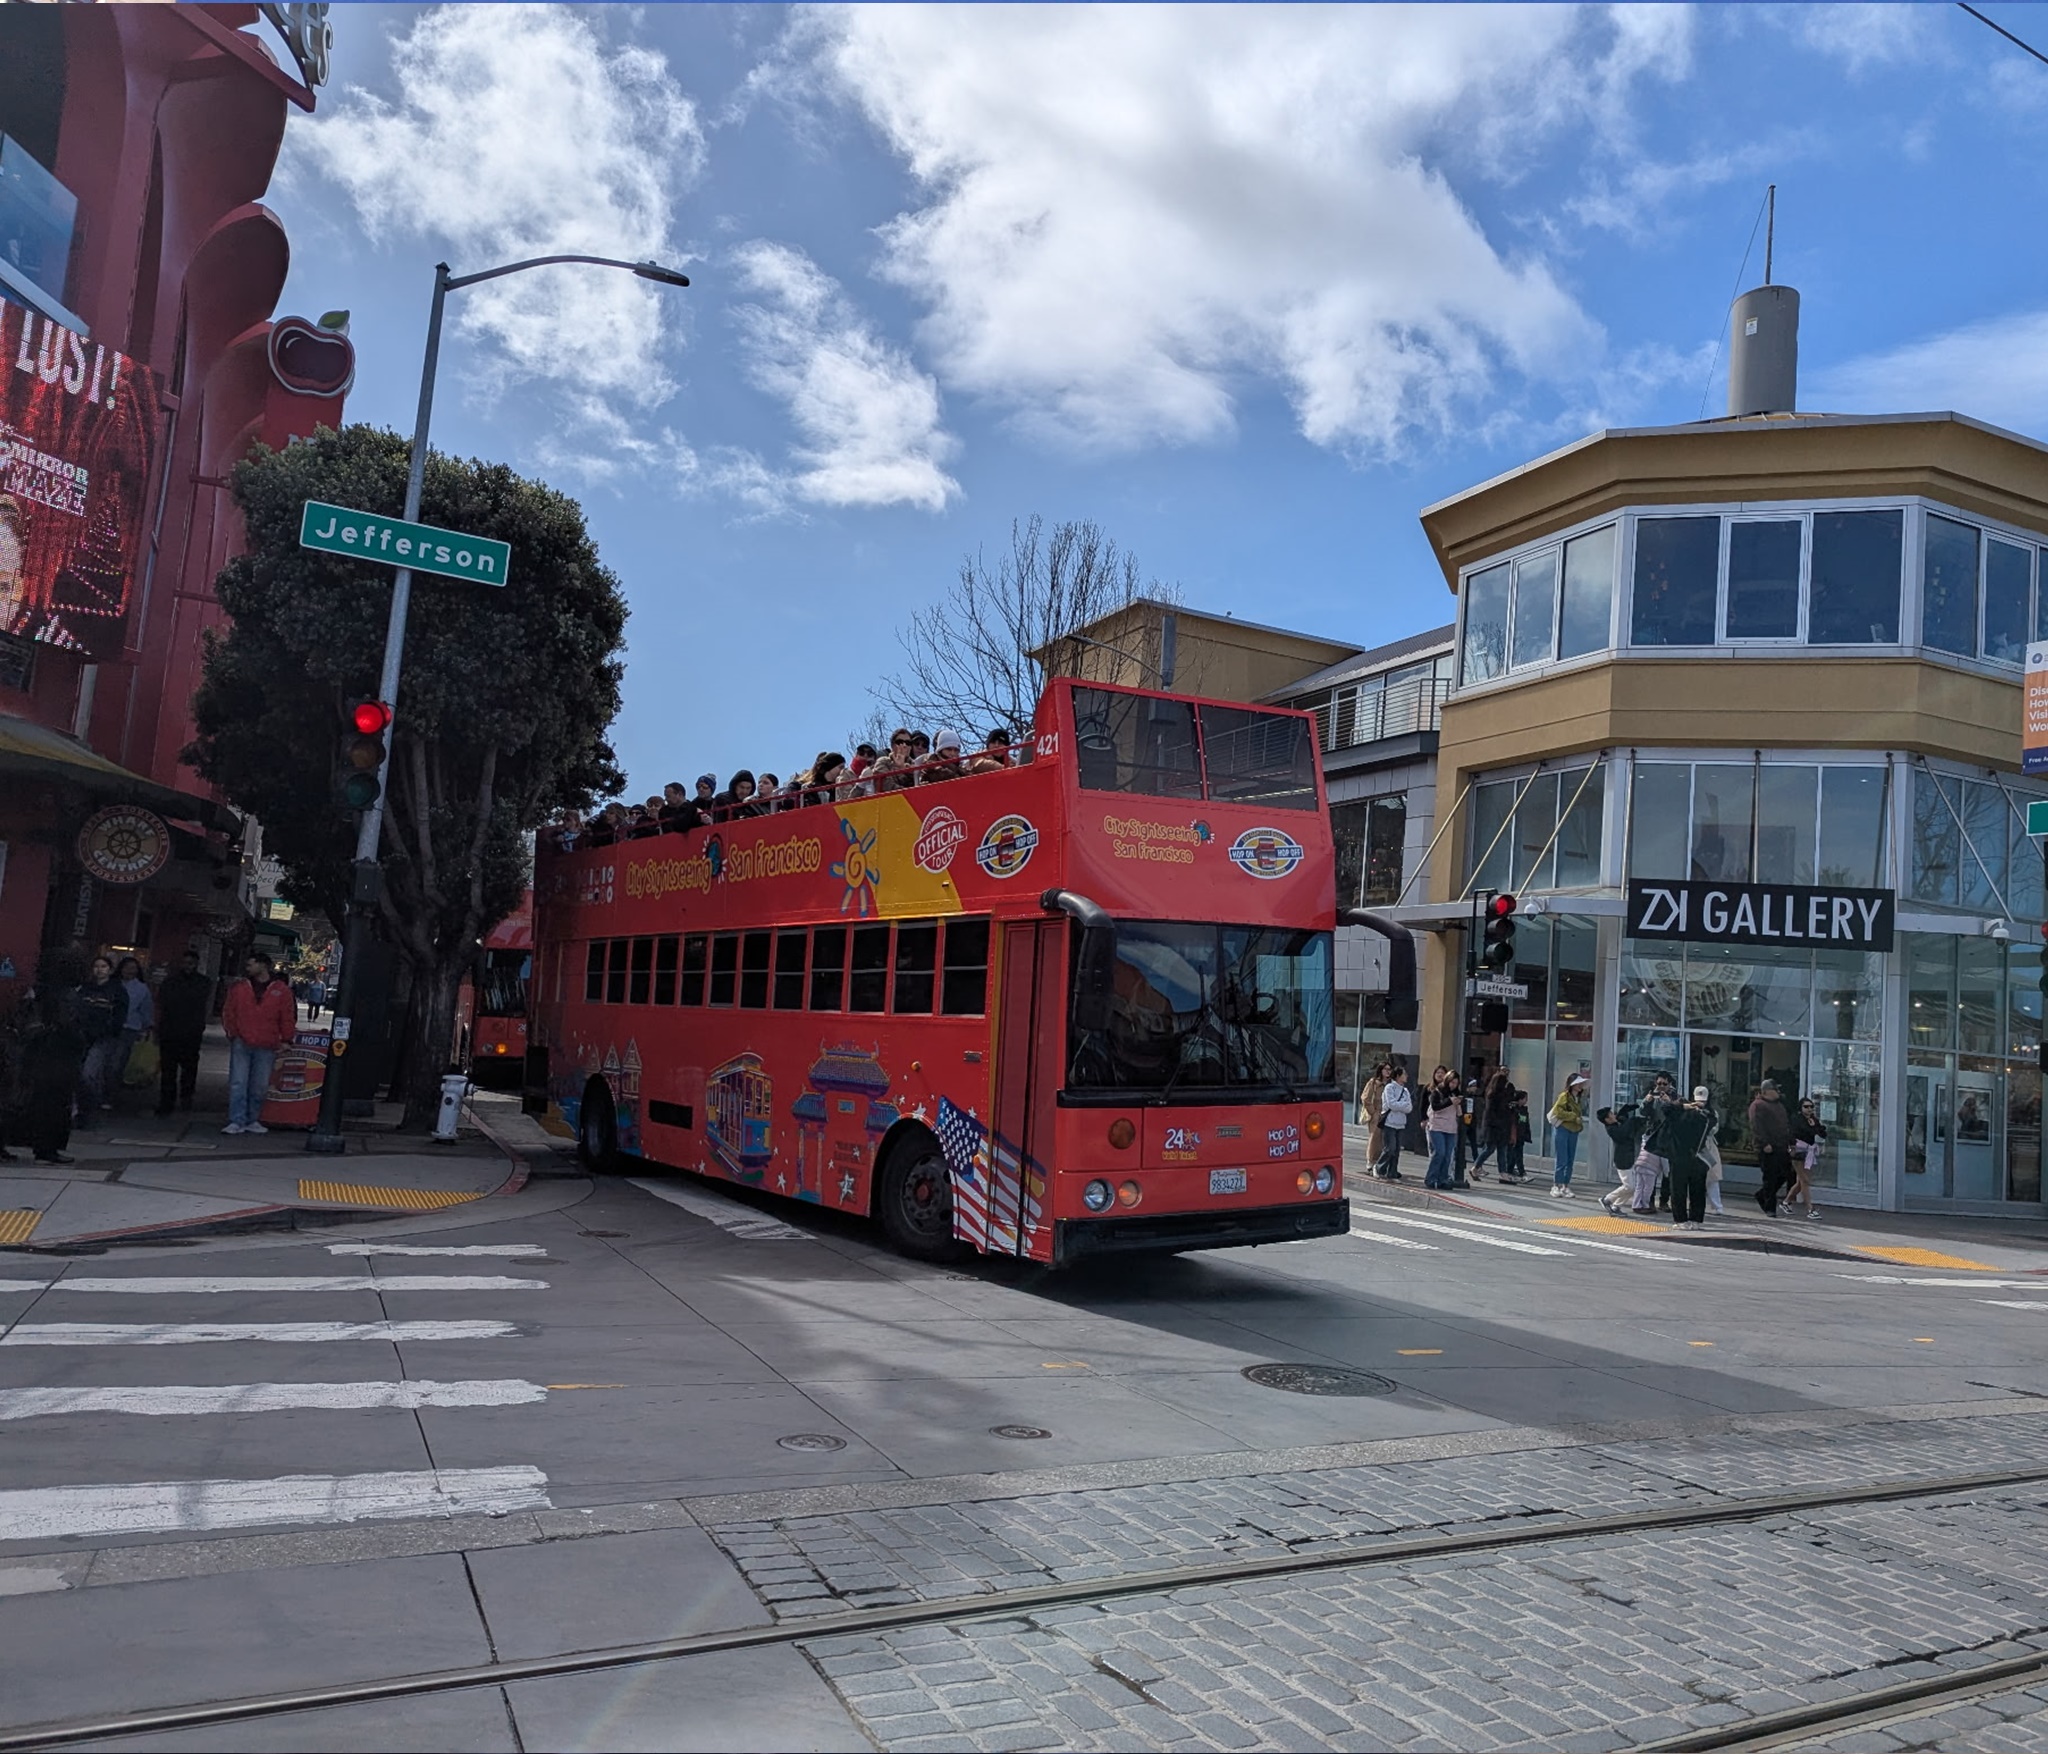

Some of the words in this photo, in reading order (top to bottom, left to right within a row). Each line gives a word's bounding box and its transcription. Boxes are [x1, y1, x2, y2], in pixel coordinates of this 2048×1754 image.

[315, 517, 495, 573] Jefferson
[1037, 731, 1058, 756] 421
[98, 815, 155, 836] WHARF
[918, 823, 964, 861] OFFICIAL
[979, 849, 989, 860] HOP
[989, 847, 997, 857] ON
[1015, 838, 1026, 848] HOP
[1027, 833, 1036, 845] OFF
[1113, 839, 1137, 859] San
[1138, 841, 1194, 864] Francisco
[1232, 850, 1244, 858] HOP
[1277, 848, 1290, 857] HOP
[1290, 848, 1301, 856] OFF
[93, 849, 154, 872] CENTRAL
[728, 843, 753, 882] San
[755, 835, 821, 879] Francisco
[932, 847, 953, 868] TOUR
[87, 860, 157, 882] SPORTSWEAR
[1703, 891, 1882, 941] GALLERY
[1481, 983, 1523, 995] Jefferson
[301, 1036, 319, 1046] HOP
[1165, 1128, 1184, 1149] 24
[1268, 1129, 1284, 1141] Hop
[1286, 1125, 1297, 1138] On
[1269, 1145, 1285, 1157] Hop
[1287, 1140, 1299, 1153] Off
